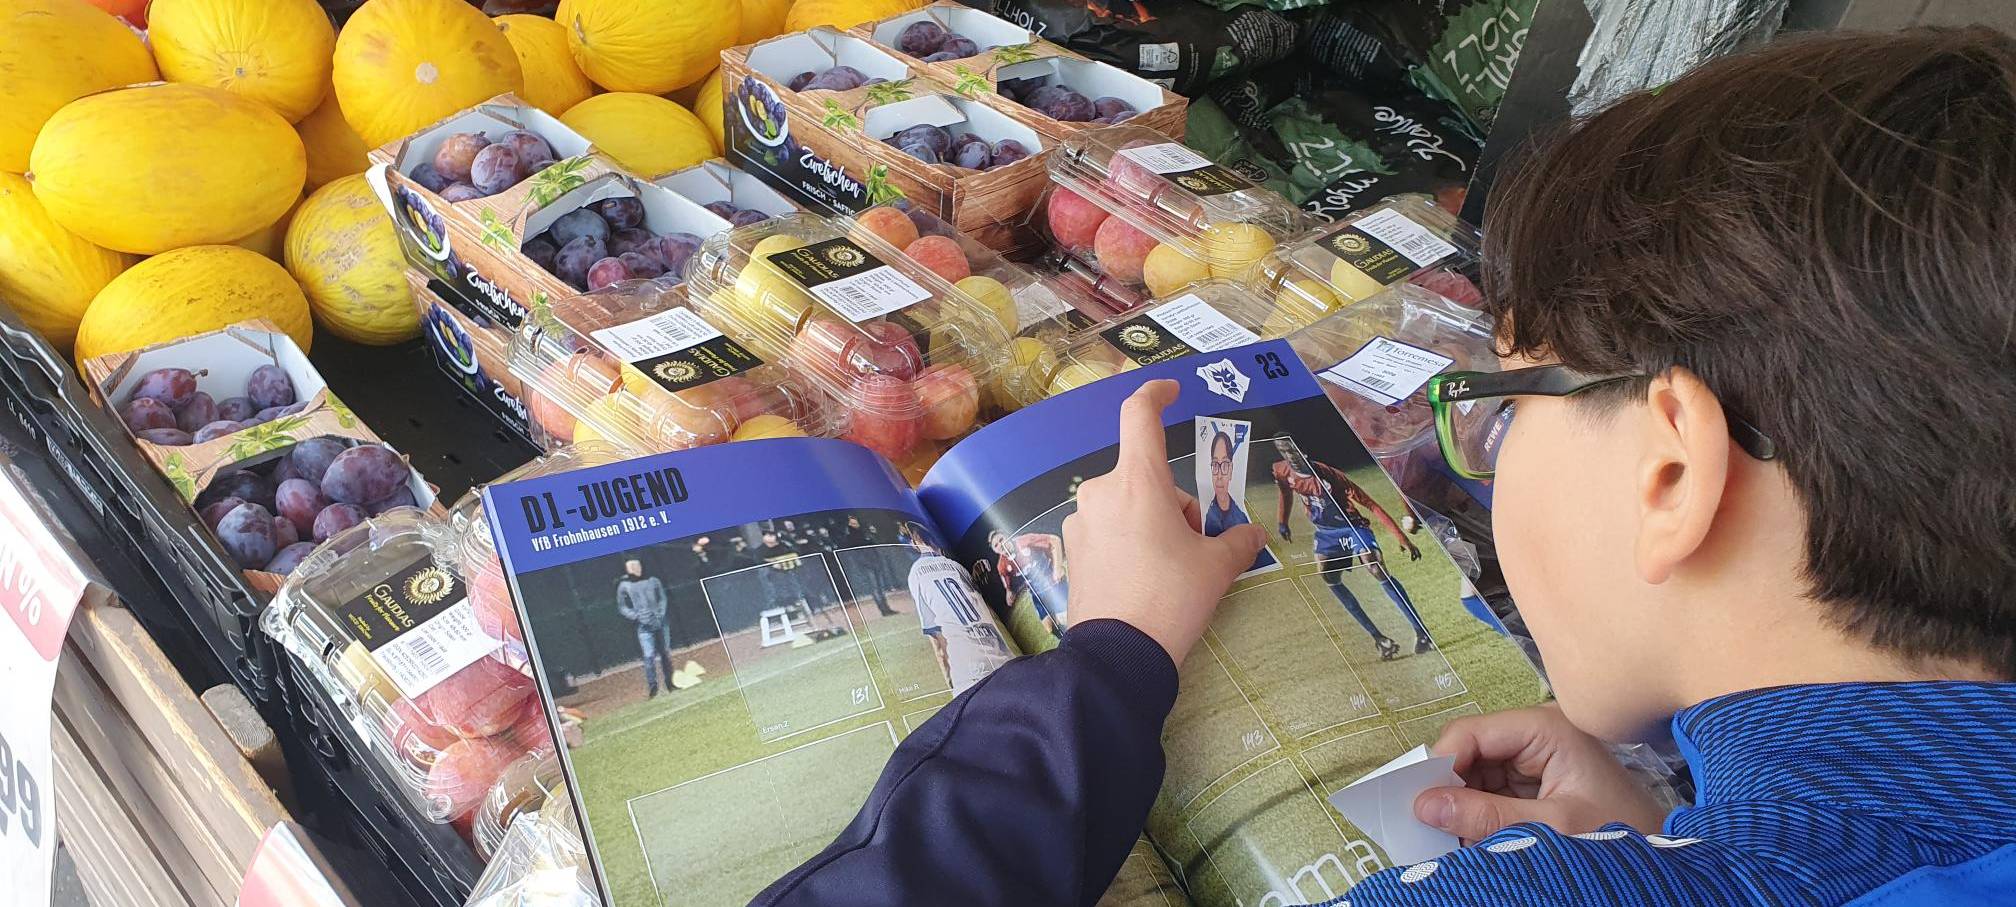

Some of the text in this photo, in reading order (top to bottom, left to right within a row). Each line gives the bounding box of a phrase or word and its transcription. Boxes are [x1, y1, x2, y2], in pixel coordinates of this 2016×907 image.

[799, 145, 861, 199] Zwetschen
[801, 180, 827, 202] FRISCH
[796, 247, 840, 279] GAUDIAS
[1353, 248, 1394, 269] GAUDIAS
[688, 348, 731, 377] GAUDIAS
[1137, 343, 1186, 367] GAUDIAS
[1254, 351, 1290, 380] 23
[1483, 419, 1503, 453] REWE
[520, 466, 690, 535] D1-JUGEND
[531, 510, 672, 552] VfB Frohnhausen 1912 e. V.
[1338, 536, 1358, 552] 142
[374, 583, 416, 629] GAUDIAS
[933, 577, 981, 626] 10
[850, 685, 870, 706] 131
[1434, 672, 1453, 691] 145
[1349, 694, 1367, 711] 144
[1241, 729, 1264, 751] 143
